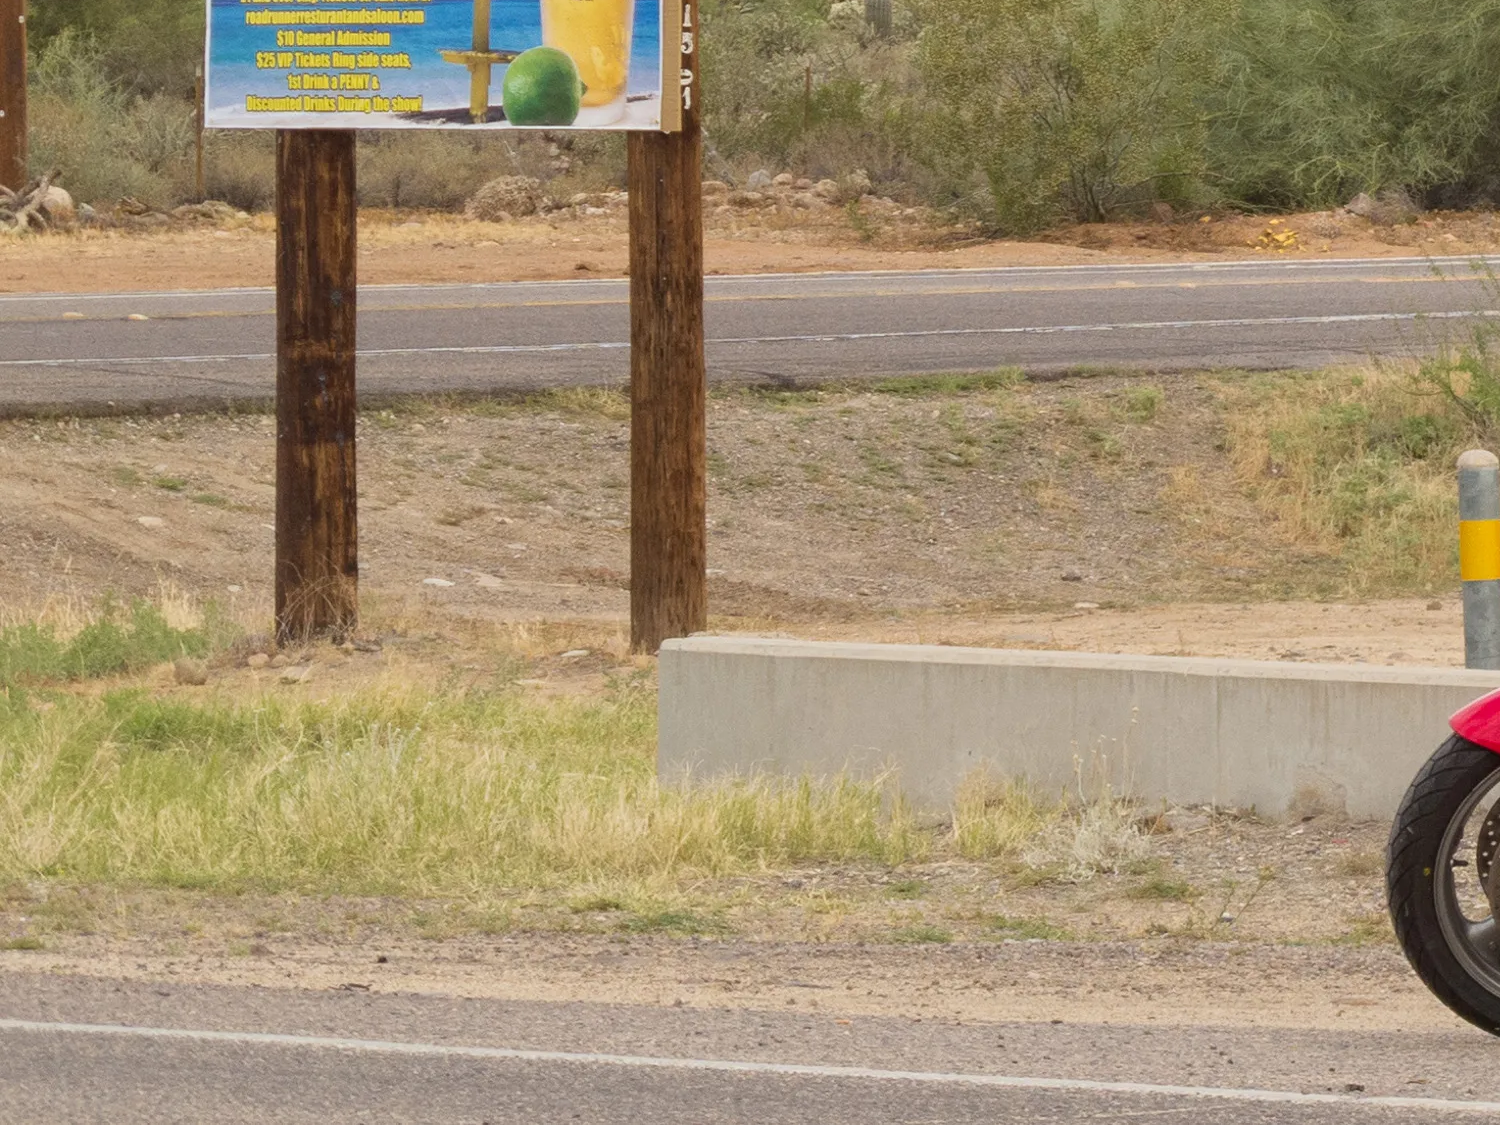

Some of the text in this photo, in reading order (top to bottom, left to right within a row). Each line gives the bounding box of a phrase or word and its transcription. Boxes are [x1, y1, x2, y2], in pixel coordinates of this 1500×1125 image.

[277, 30, 391, 47] $10 General Admission
[256, 51, 276, 69] $25
[277, 51, 293, 67] VIP
[295, 51, 330, 68] Tickets
[332, 52, 356, 69] Ring
[357, 51, 379, 68] side
[286, 73, 380, 90] 1st Drink a PENNY &
[246, 95, 423, 113] Discounted Drinks During the show!
